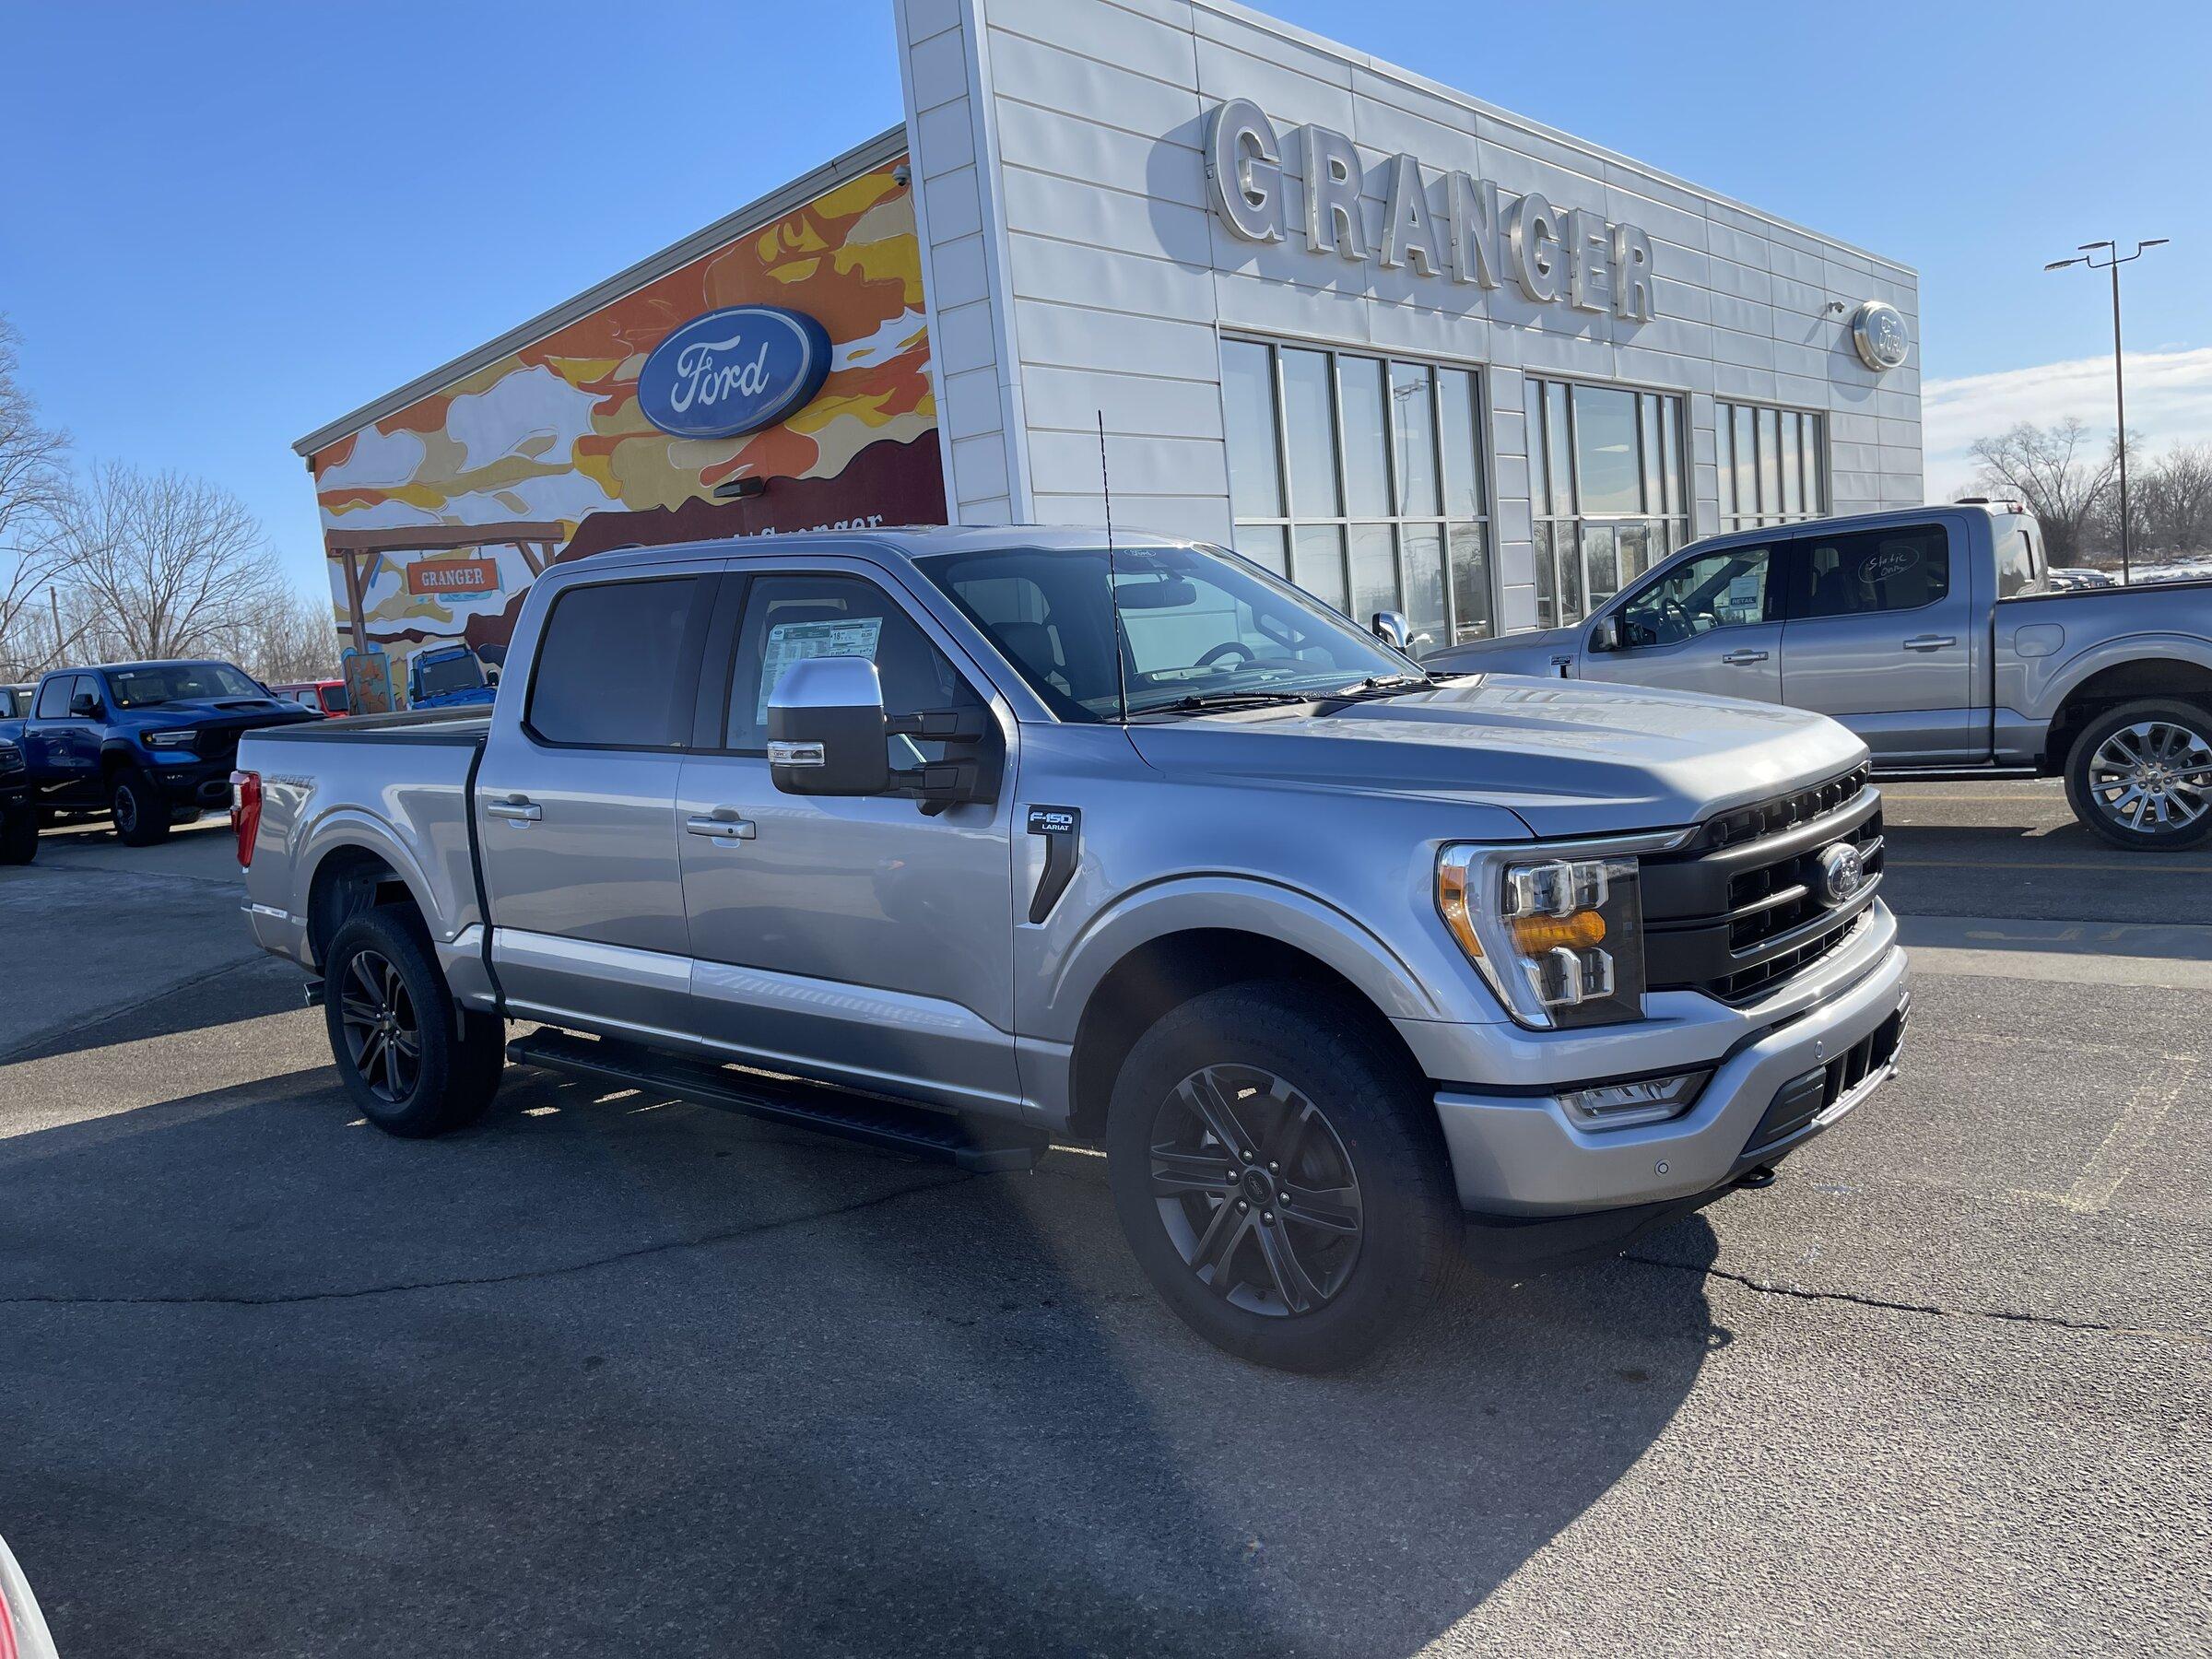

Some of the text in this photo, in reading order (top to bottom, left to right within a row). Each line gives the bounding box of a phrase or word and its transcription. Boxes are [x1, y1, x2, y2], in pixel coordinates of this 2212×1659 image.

[1206, 97, 1656, 323] GRANGER
[1879, 315, 1902, 354] Ford
[670, 335, 770, 413] Ford
[1869, 553, 1907, 571] Static
[421, 568, 485, 586] GRANGER
[1030, 811, 1073, 824] F-150
